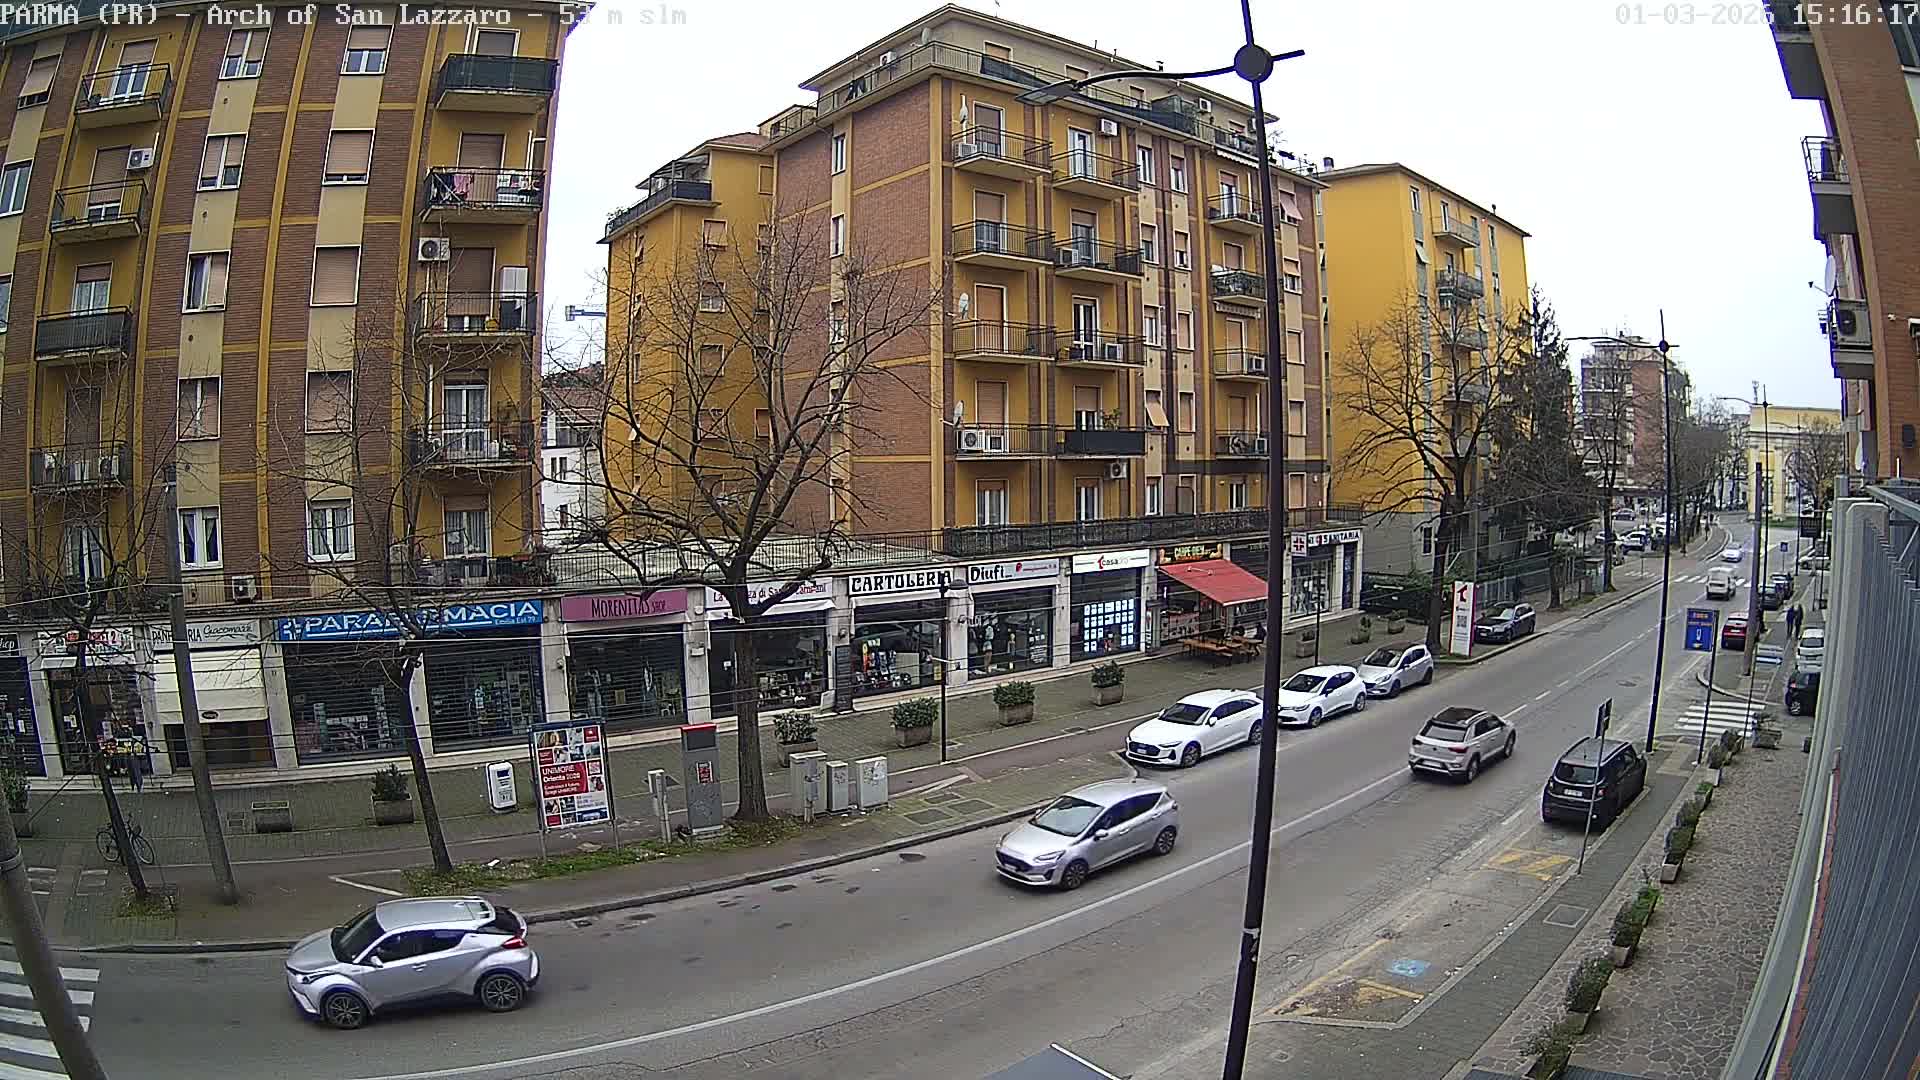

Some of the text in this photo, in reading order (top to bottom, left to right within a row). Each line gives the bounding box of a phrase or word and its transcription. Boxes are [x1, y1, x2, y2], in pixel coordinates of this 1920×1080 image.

[851, 570, 951, 592] CARTOLERIA
[306, 602, 539, 632] PARAFRMACIA
[591, 597, 650, 618] MORENITAS
